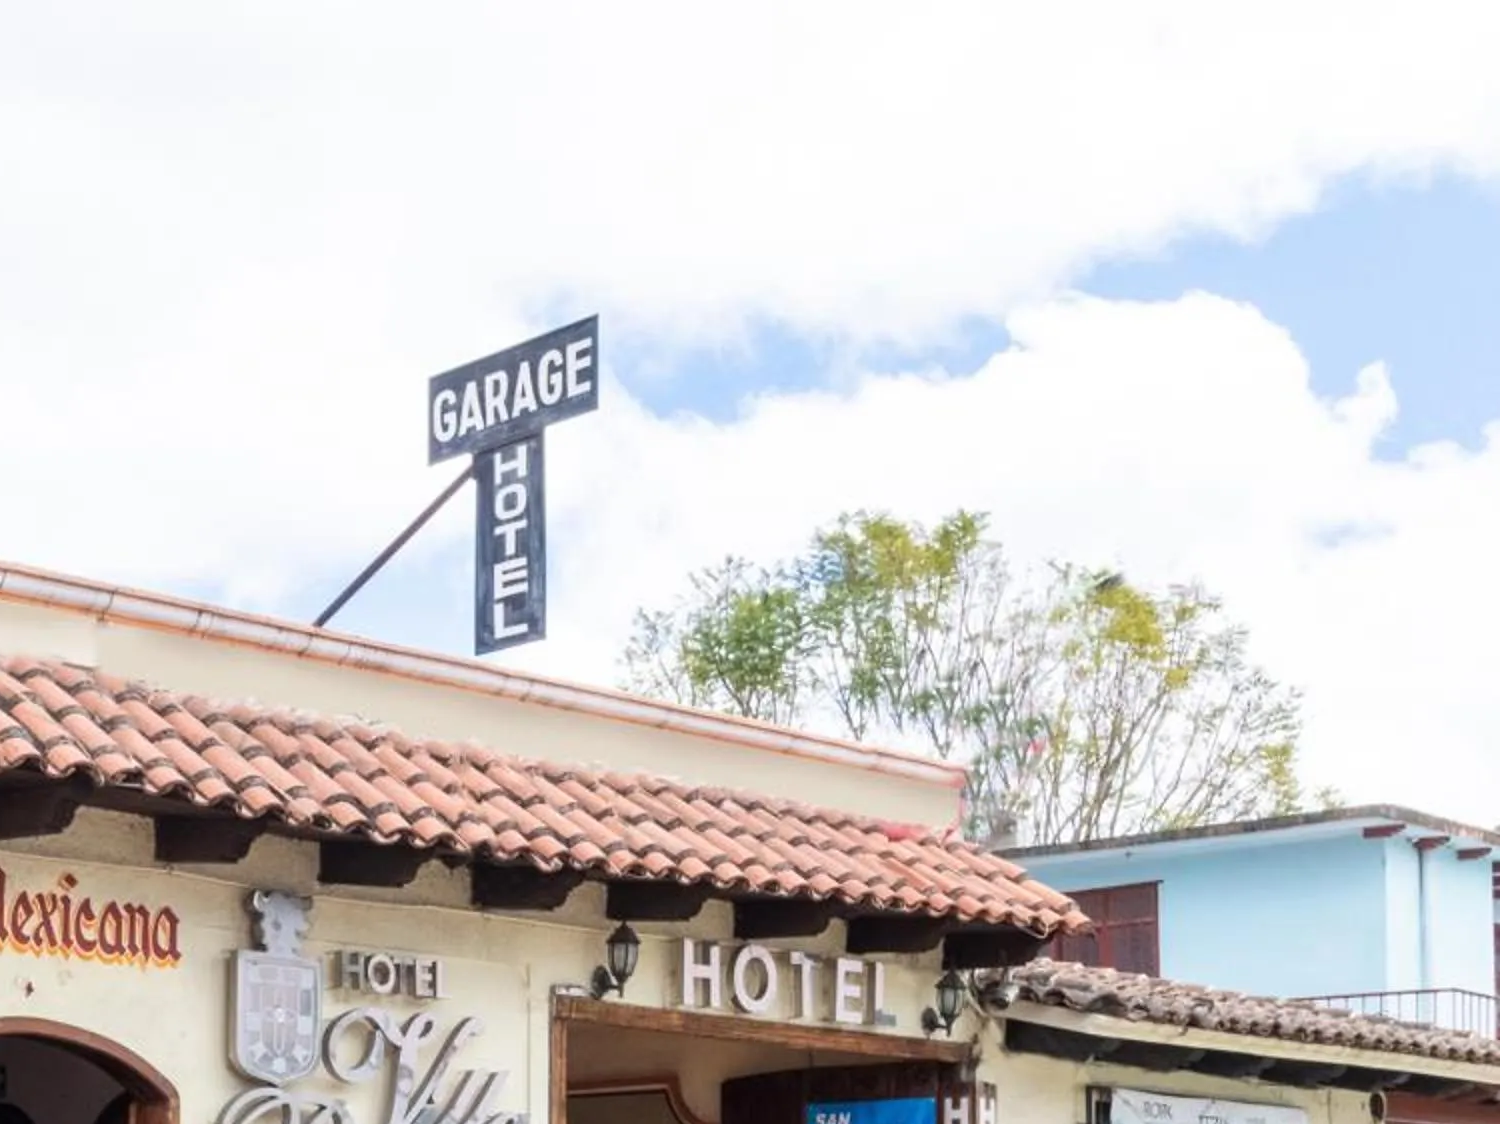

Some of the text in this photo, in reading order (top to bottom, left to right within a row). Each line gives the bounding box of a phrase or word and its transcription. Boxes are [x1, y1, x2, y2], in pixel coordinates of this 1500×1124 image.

[432, 336, 593, 443] GARAGE
[492, 444, 529, 640] HOTEL
[328, 949, 453, 999] HOTEL
[681, 937, 897, 1027] HOTEL
